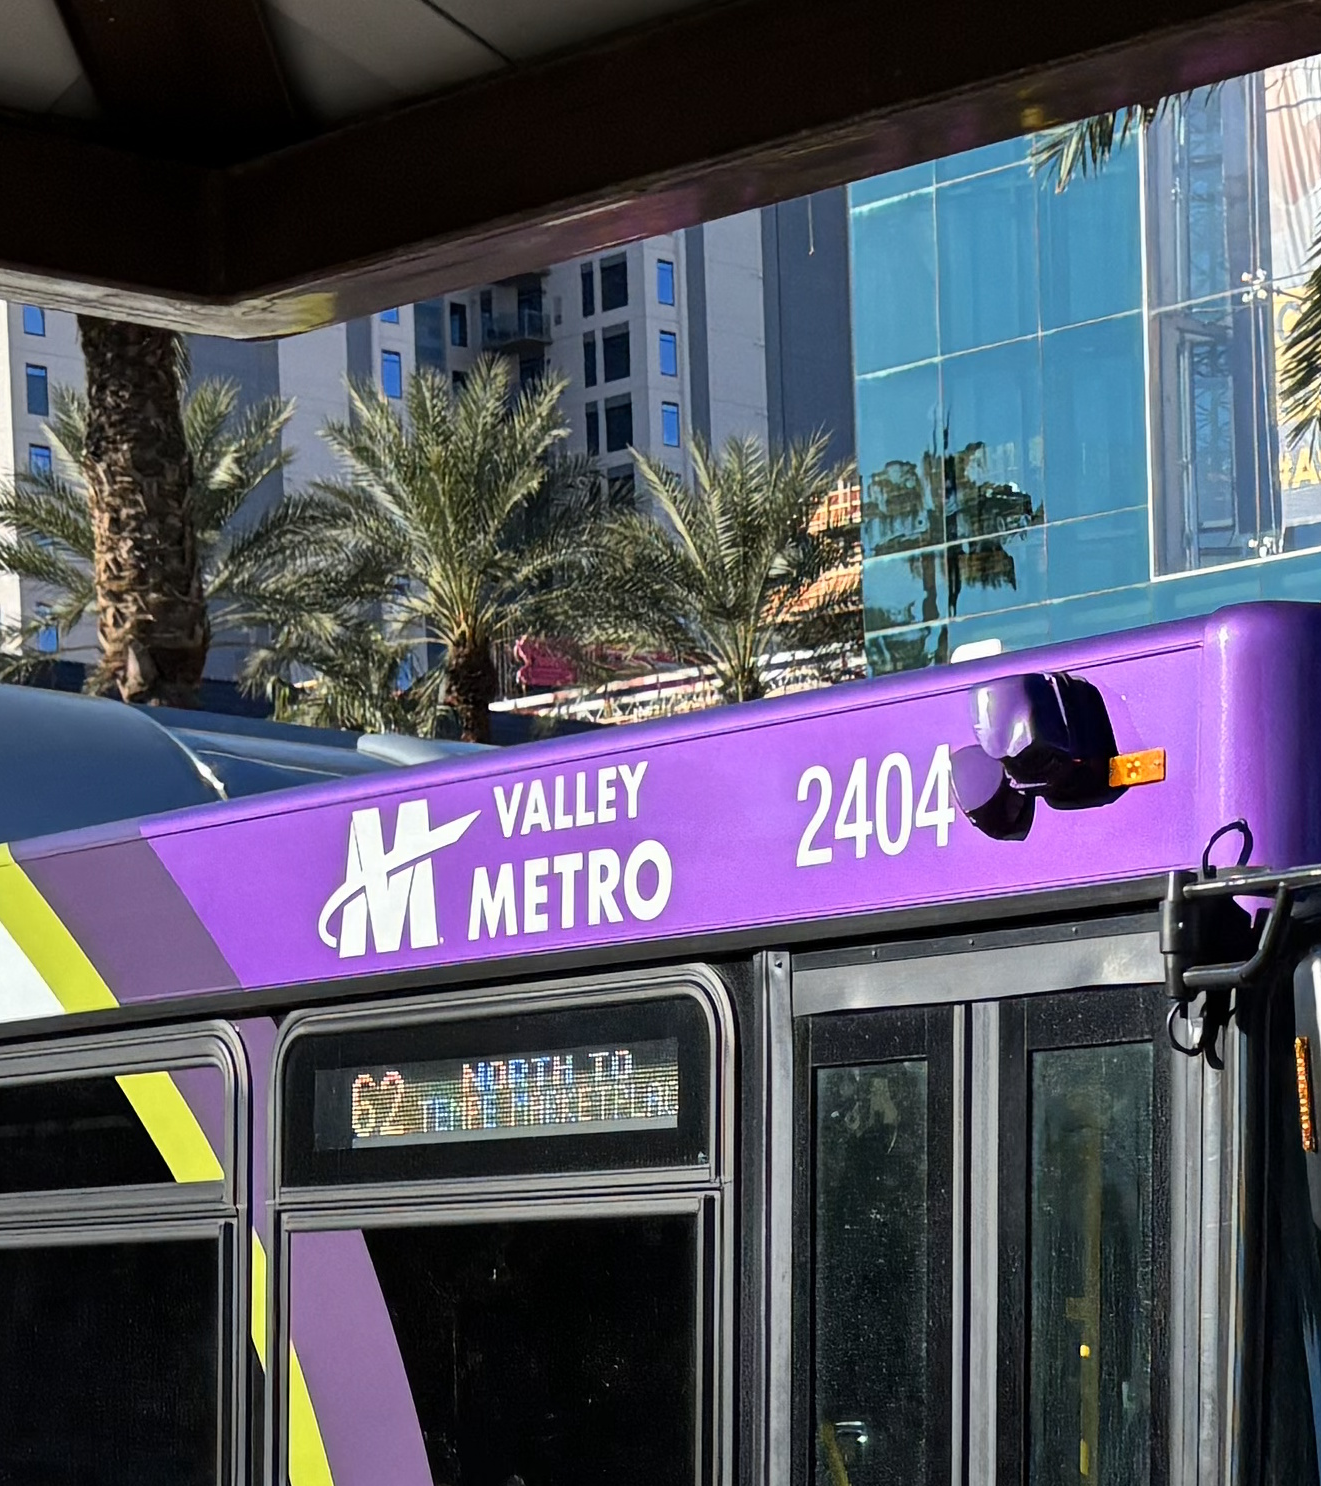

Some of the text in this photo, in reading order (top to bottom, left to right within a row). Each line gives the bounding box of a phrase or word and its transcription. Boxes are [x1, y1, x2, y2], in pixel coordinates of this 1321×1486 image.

[493, 760, 649, 838] VALLEY
[796, 743, 955, 868] 2404
[467, 838, 673, 941] METRO
[352, 1071, 405, 1138] 62
[462, 1050, 633, 1092] NORTH TO
